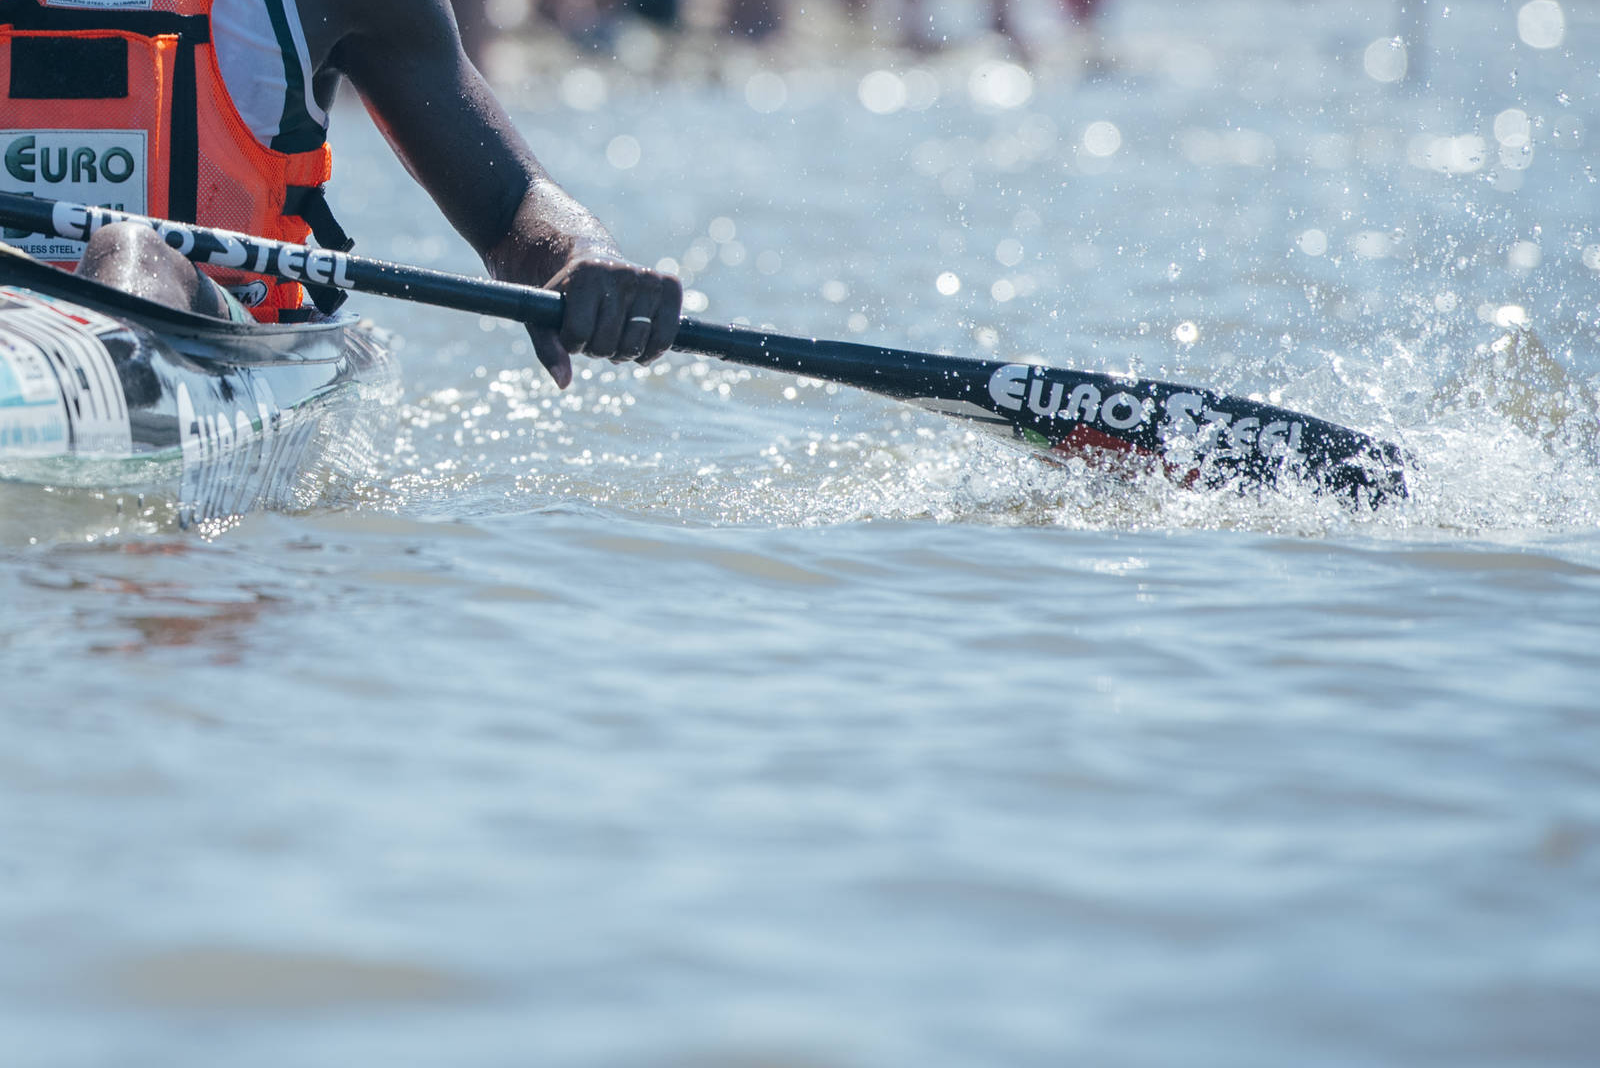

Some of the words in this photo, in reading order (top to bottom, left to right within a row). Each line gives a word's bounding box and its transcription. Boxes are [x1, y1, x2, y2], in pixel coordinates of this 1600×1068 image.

[5, 135, 135, 184] EURO
[50, 244, 75, 254] STEEL
[208, 228, 355, 288] STEEL
[988, 364, 1142, 430] EURO
